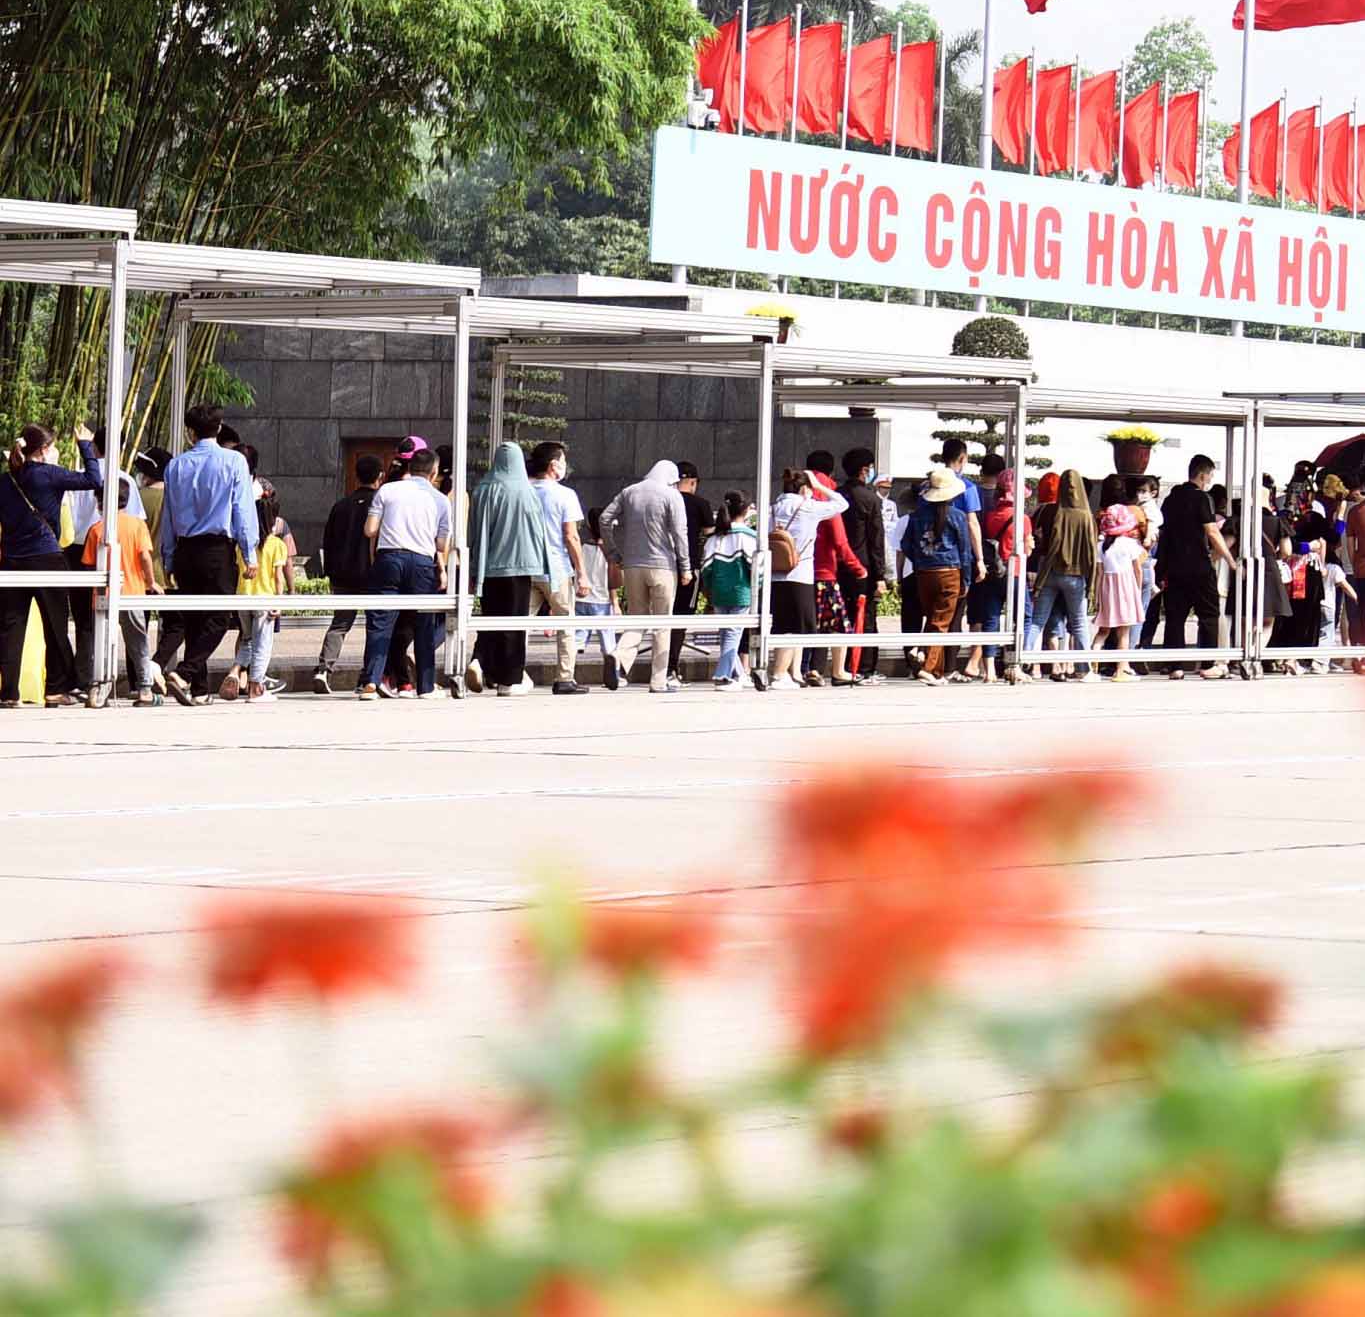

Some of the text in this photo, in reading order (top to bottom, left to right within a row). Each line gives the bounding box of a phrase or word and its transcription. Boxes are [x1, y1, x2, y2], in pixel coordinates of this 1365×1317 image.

[746, 163, 899, 263] NƯỚC
[925, 180, 1062, 288] CỘNG
[1087, 201, 1178, 294] HÒA
[1200, 216, 1256, 302] XÃ
[1278, 226, 1348, 323] HỘI
